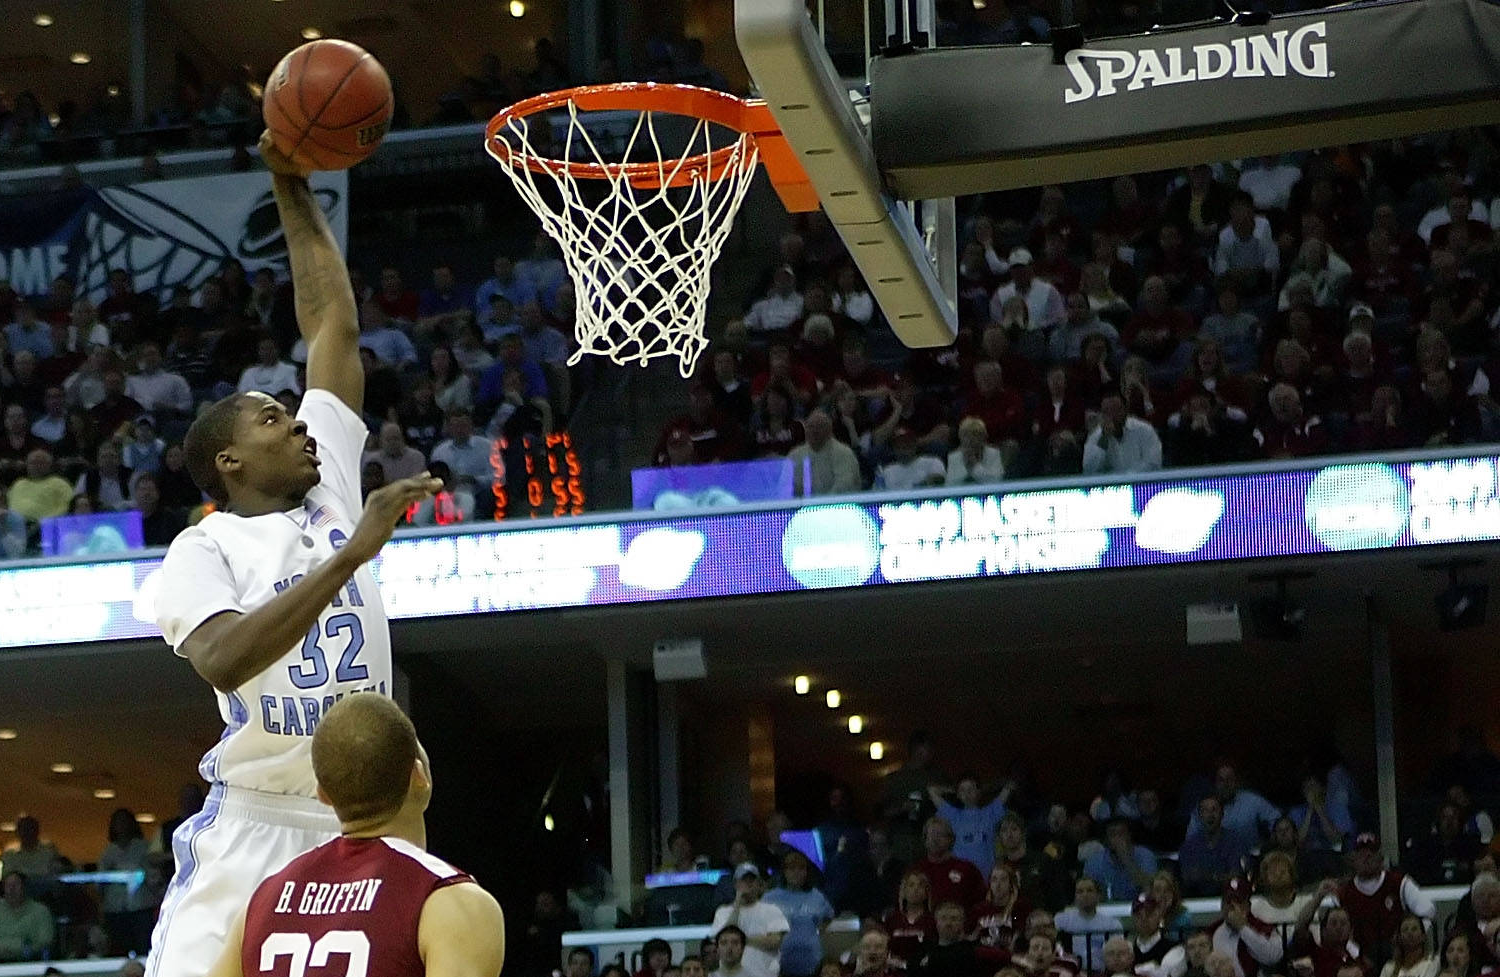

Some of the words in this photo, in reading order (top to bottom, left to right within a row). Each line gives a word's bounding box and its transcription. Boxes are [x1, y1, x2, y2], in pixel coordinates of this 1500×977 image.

[1065, 22, 1329, 103] SPALDING
[288, 613, 369, 690] 32
[275, 881, 295, 913] B.
[298, 879, 382, 915] GRIFFIN
